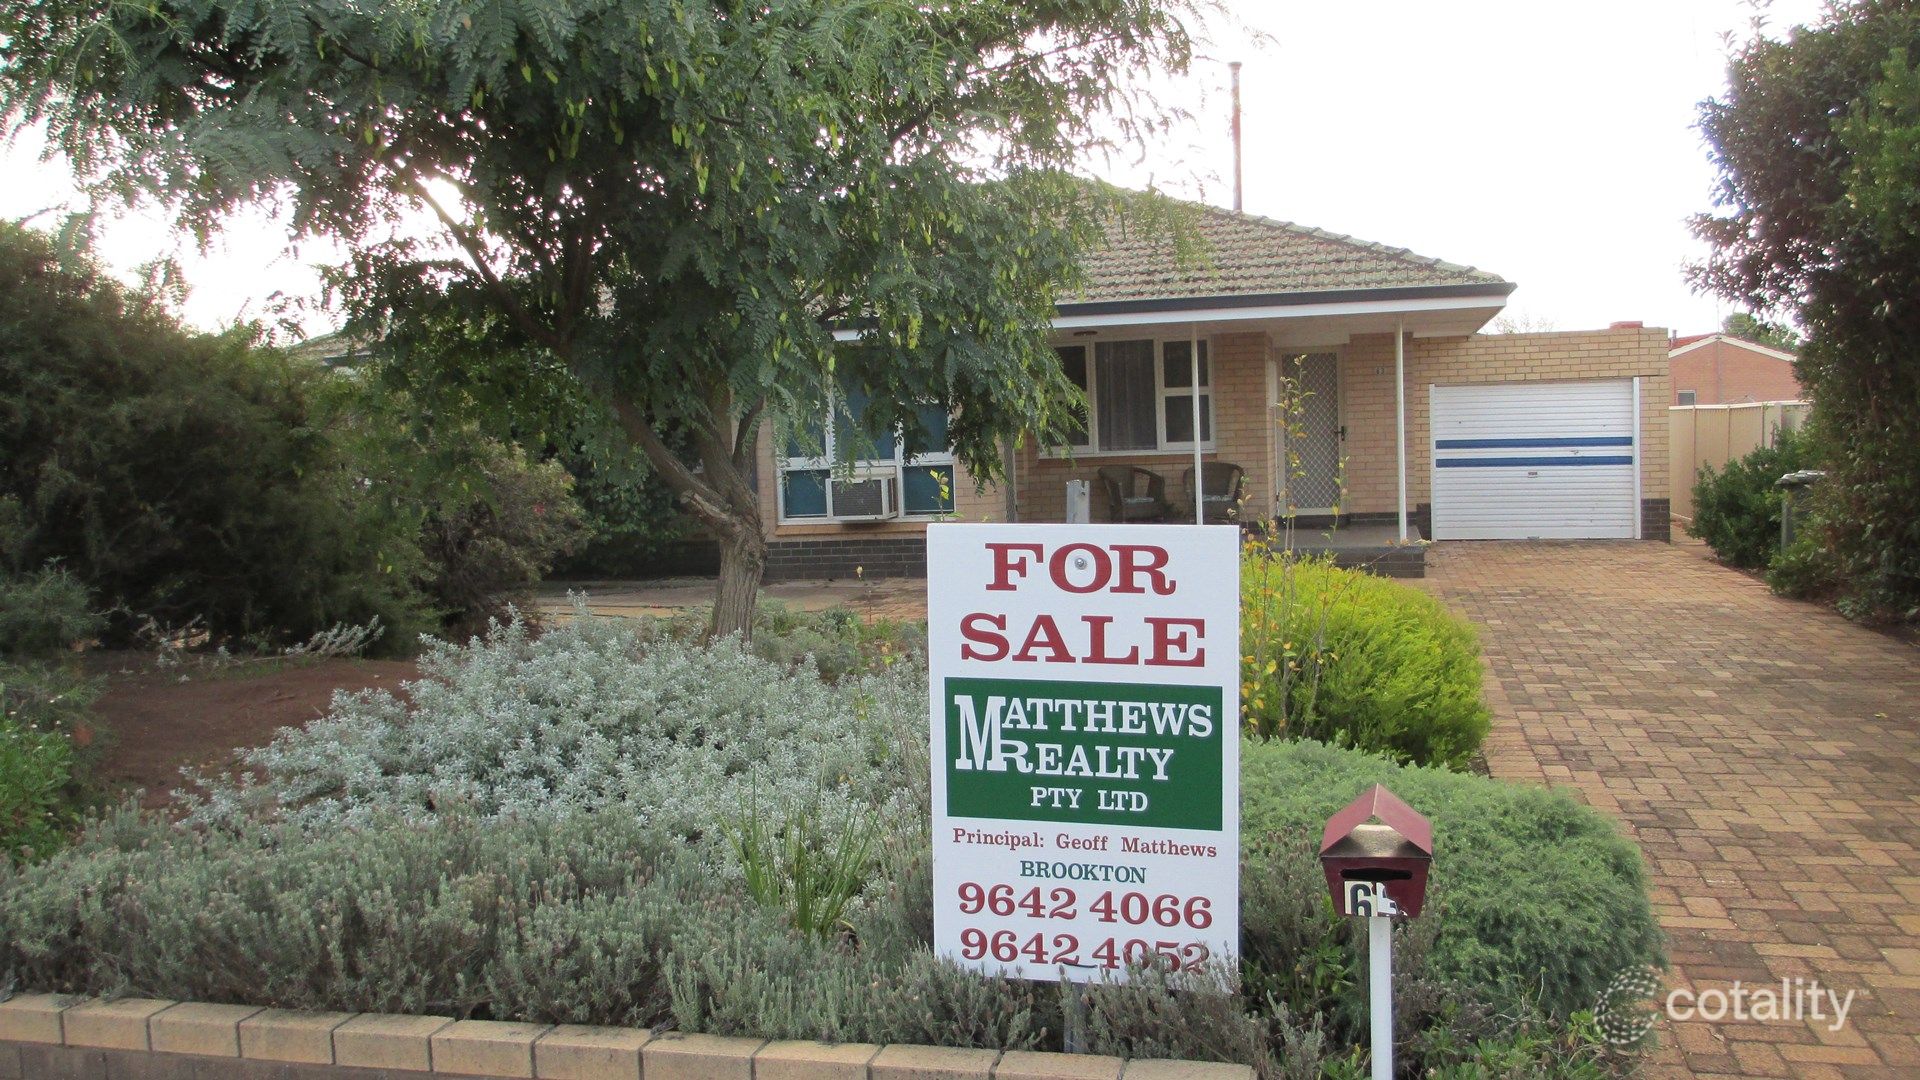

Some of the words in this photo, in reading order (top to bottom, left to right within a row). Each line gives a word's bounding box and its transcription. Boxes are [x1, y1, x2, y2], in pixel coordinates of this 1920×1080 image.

[985, 543, 1176, 595] FOR
[960, 612, 1205, 667] SALE
[954, 694, 1213, 771] MATTHEWS
[988, 739, 1174, 780] REALTY
[1030, 786, 1083, 809] PTY
[1097, 789, 1149, 812] LTD
[953, 828, 1044, 851] Principal:
[1056, 833, 1109, 851] Geoff
[1121, 836, 1217, 858] Matthews
[1020, 860, 1147, 884] BROOKTON
[958, 881, 1078, 920] 9642
[1089, 890, 1213, 929] 4066
[960, 927, 1080, 965] 9642
[1091, 937, 1210, 975] 4052
